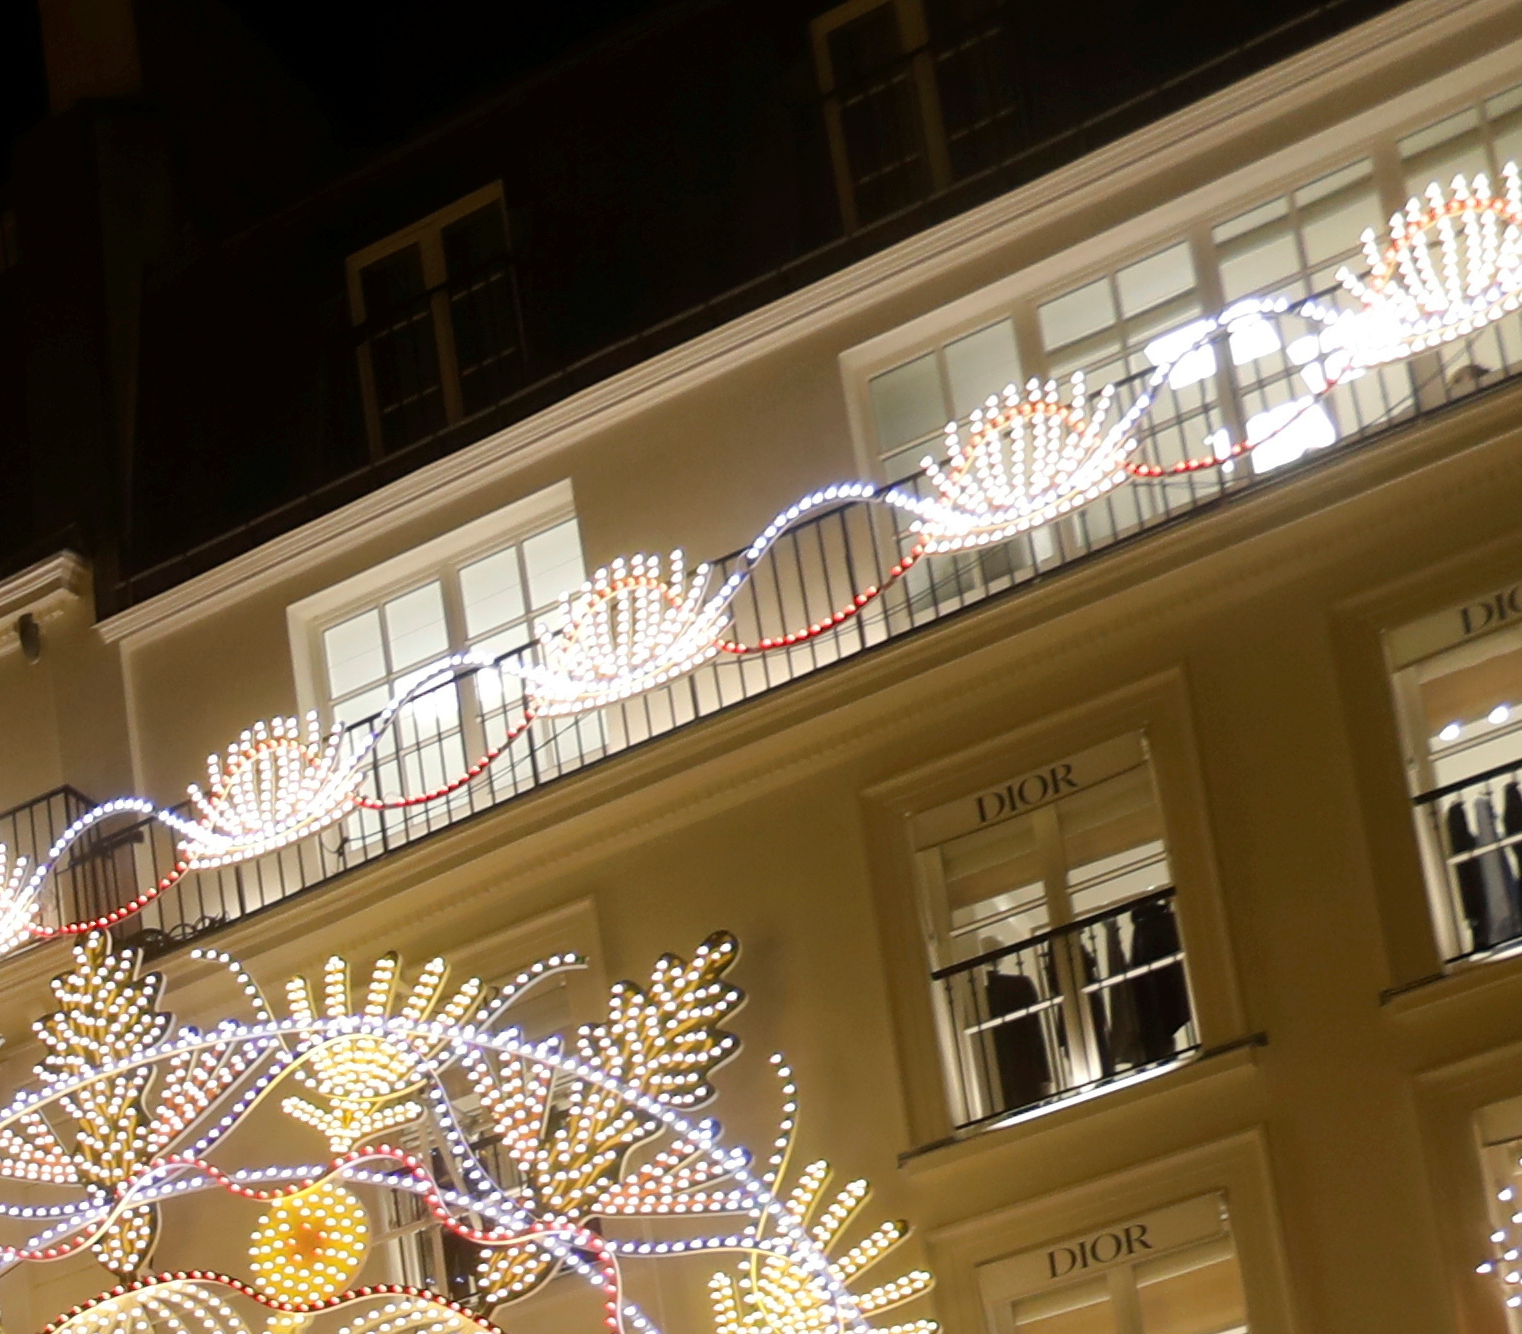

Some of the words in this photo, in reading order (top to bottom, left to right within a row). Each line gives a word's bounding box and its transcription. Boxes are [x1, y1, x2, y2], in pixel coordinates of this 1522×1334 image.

[1461, 586, 1522, 635] DI
[975, 764, 1078, 823] DIOR
[1048, 1224, 1153, 1278] DIOR
